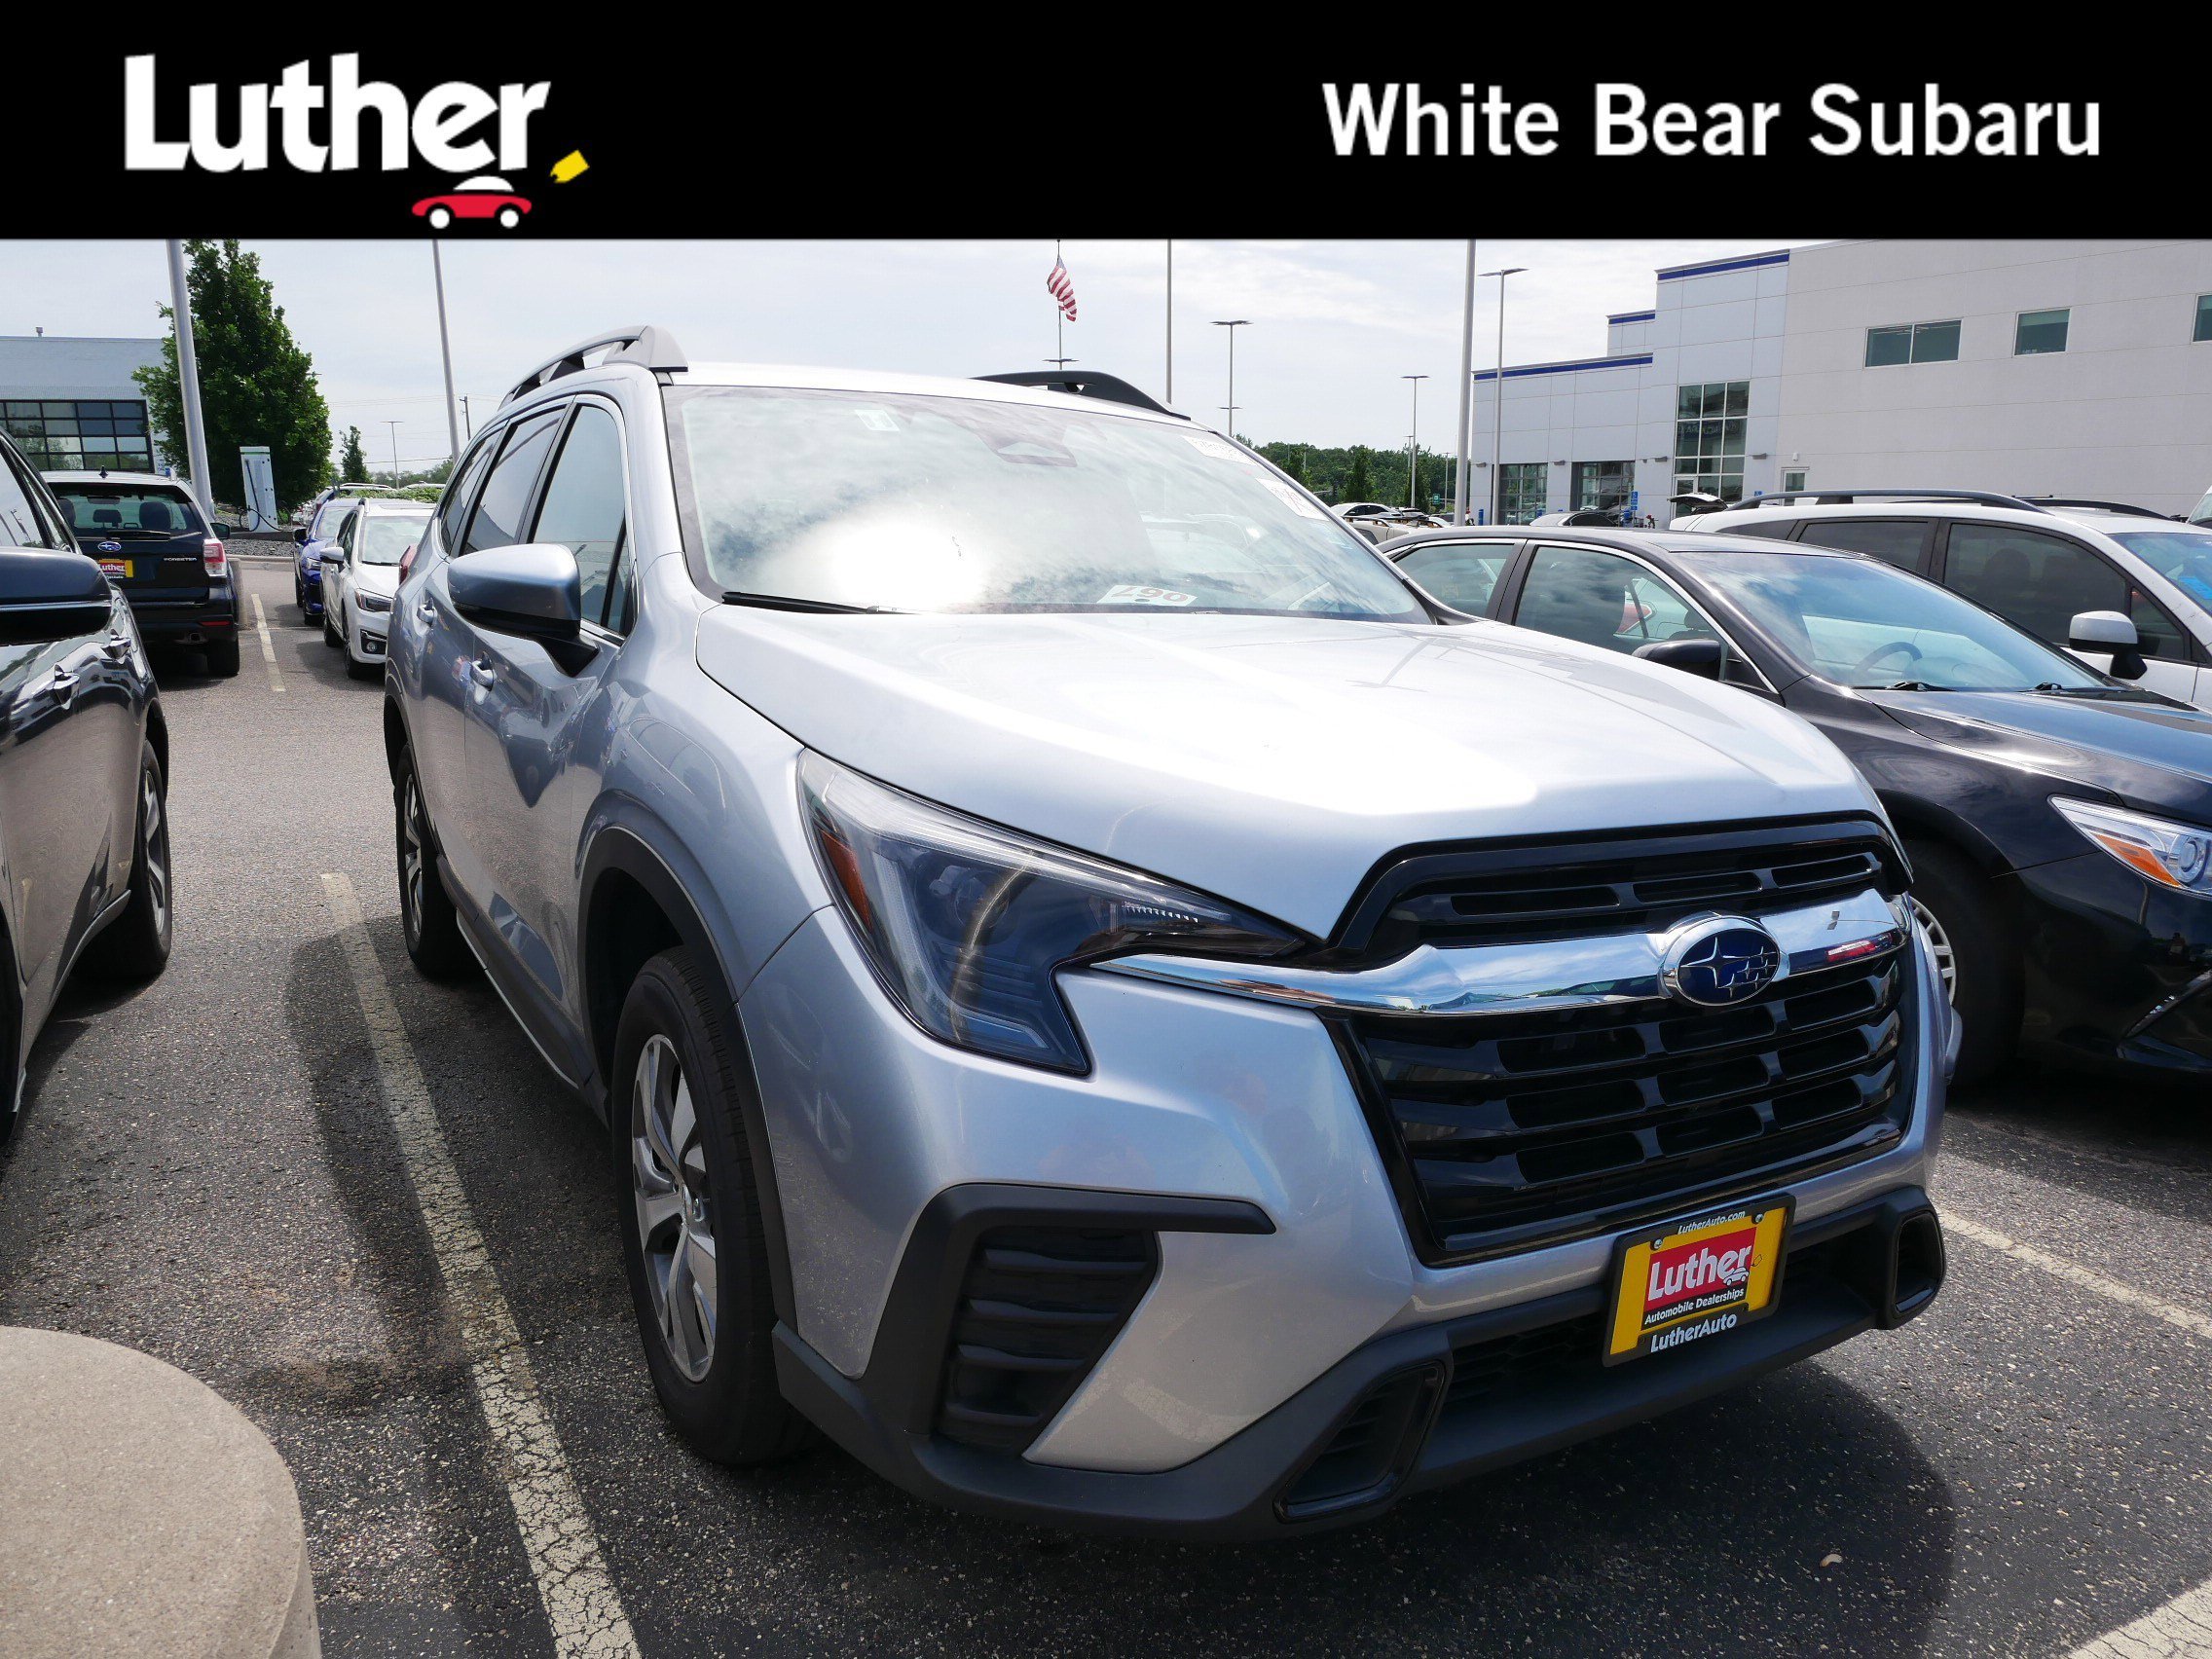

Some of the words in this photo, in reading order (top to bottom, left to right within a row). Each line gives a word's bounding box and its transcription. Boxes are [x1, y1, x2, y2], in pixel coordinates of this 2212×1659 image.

[1677, 1210, 1746, 1235] LutherAuto.com
[1647, 1244, 1752, 1301] Luther
[1644, 1301, 1694, 1325] Automobile
[1696, 1287, 1745, 1309] Dealerships
[1650, 1313, 1738, 1353] LutherAuto
